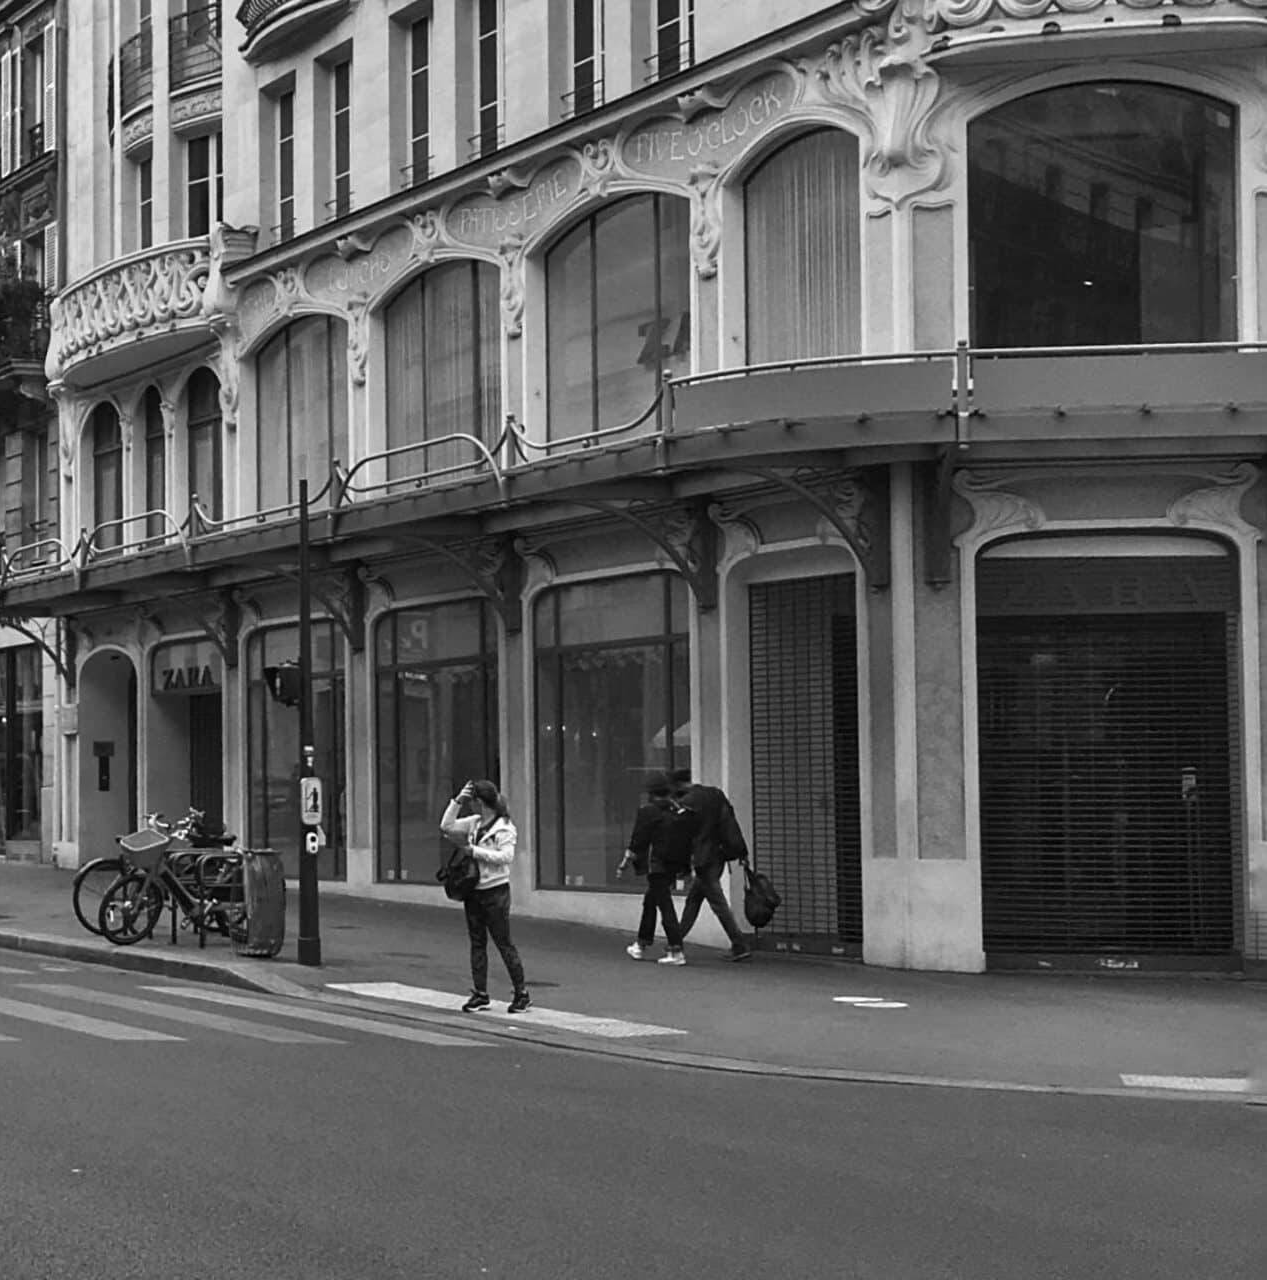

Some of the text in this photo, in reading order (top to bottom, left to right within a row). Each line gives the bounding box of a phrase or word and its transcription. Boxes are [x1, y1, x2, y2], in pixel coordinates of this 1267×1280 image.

[636, 80, 782, 162] FIVE O'CLOCK
[162, 665, 215, 691] ZARA
